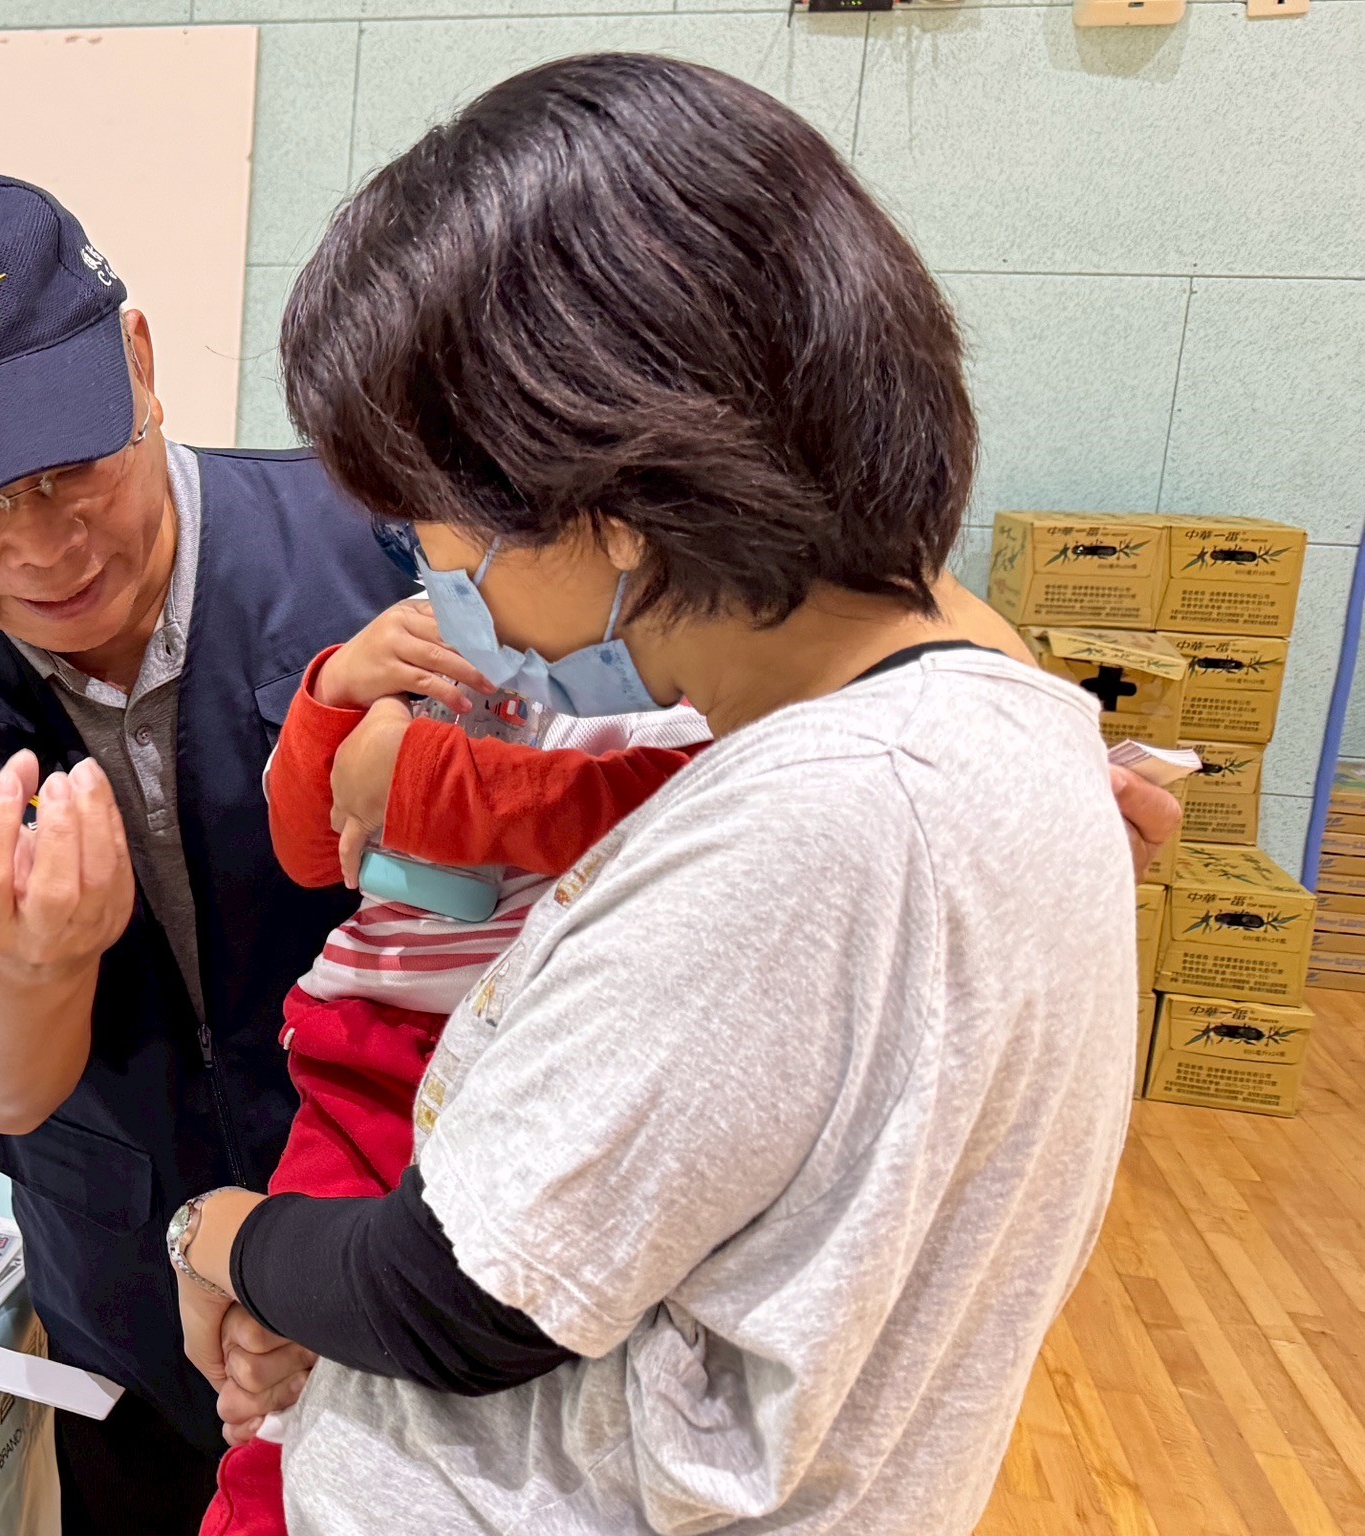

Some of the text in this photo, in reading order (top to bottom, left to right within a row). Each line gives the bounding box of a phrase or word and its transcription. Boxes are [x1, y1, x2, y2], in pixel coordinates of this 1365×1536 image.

[1185, 530, 1239, 542] 中華一番
[1176, 641, 1231, 654] 中華一番
[1187, 893, 1248, 907] 中華一番
[1189, 1006, 1249, 1021] 中華一番
